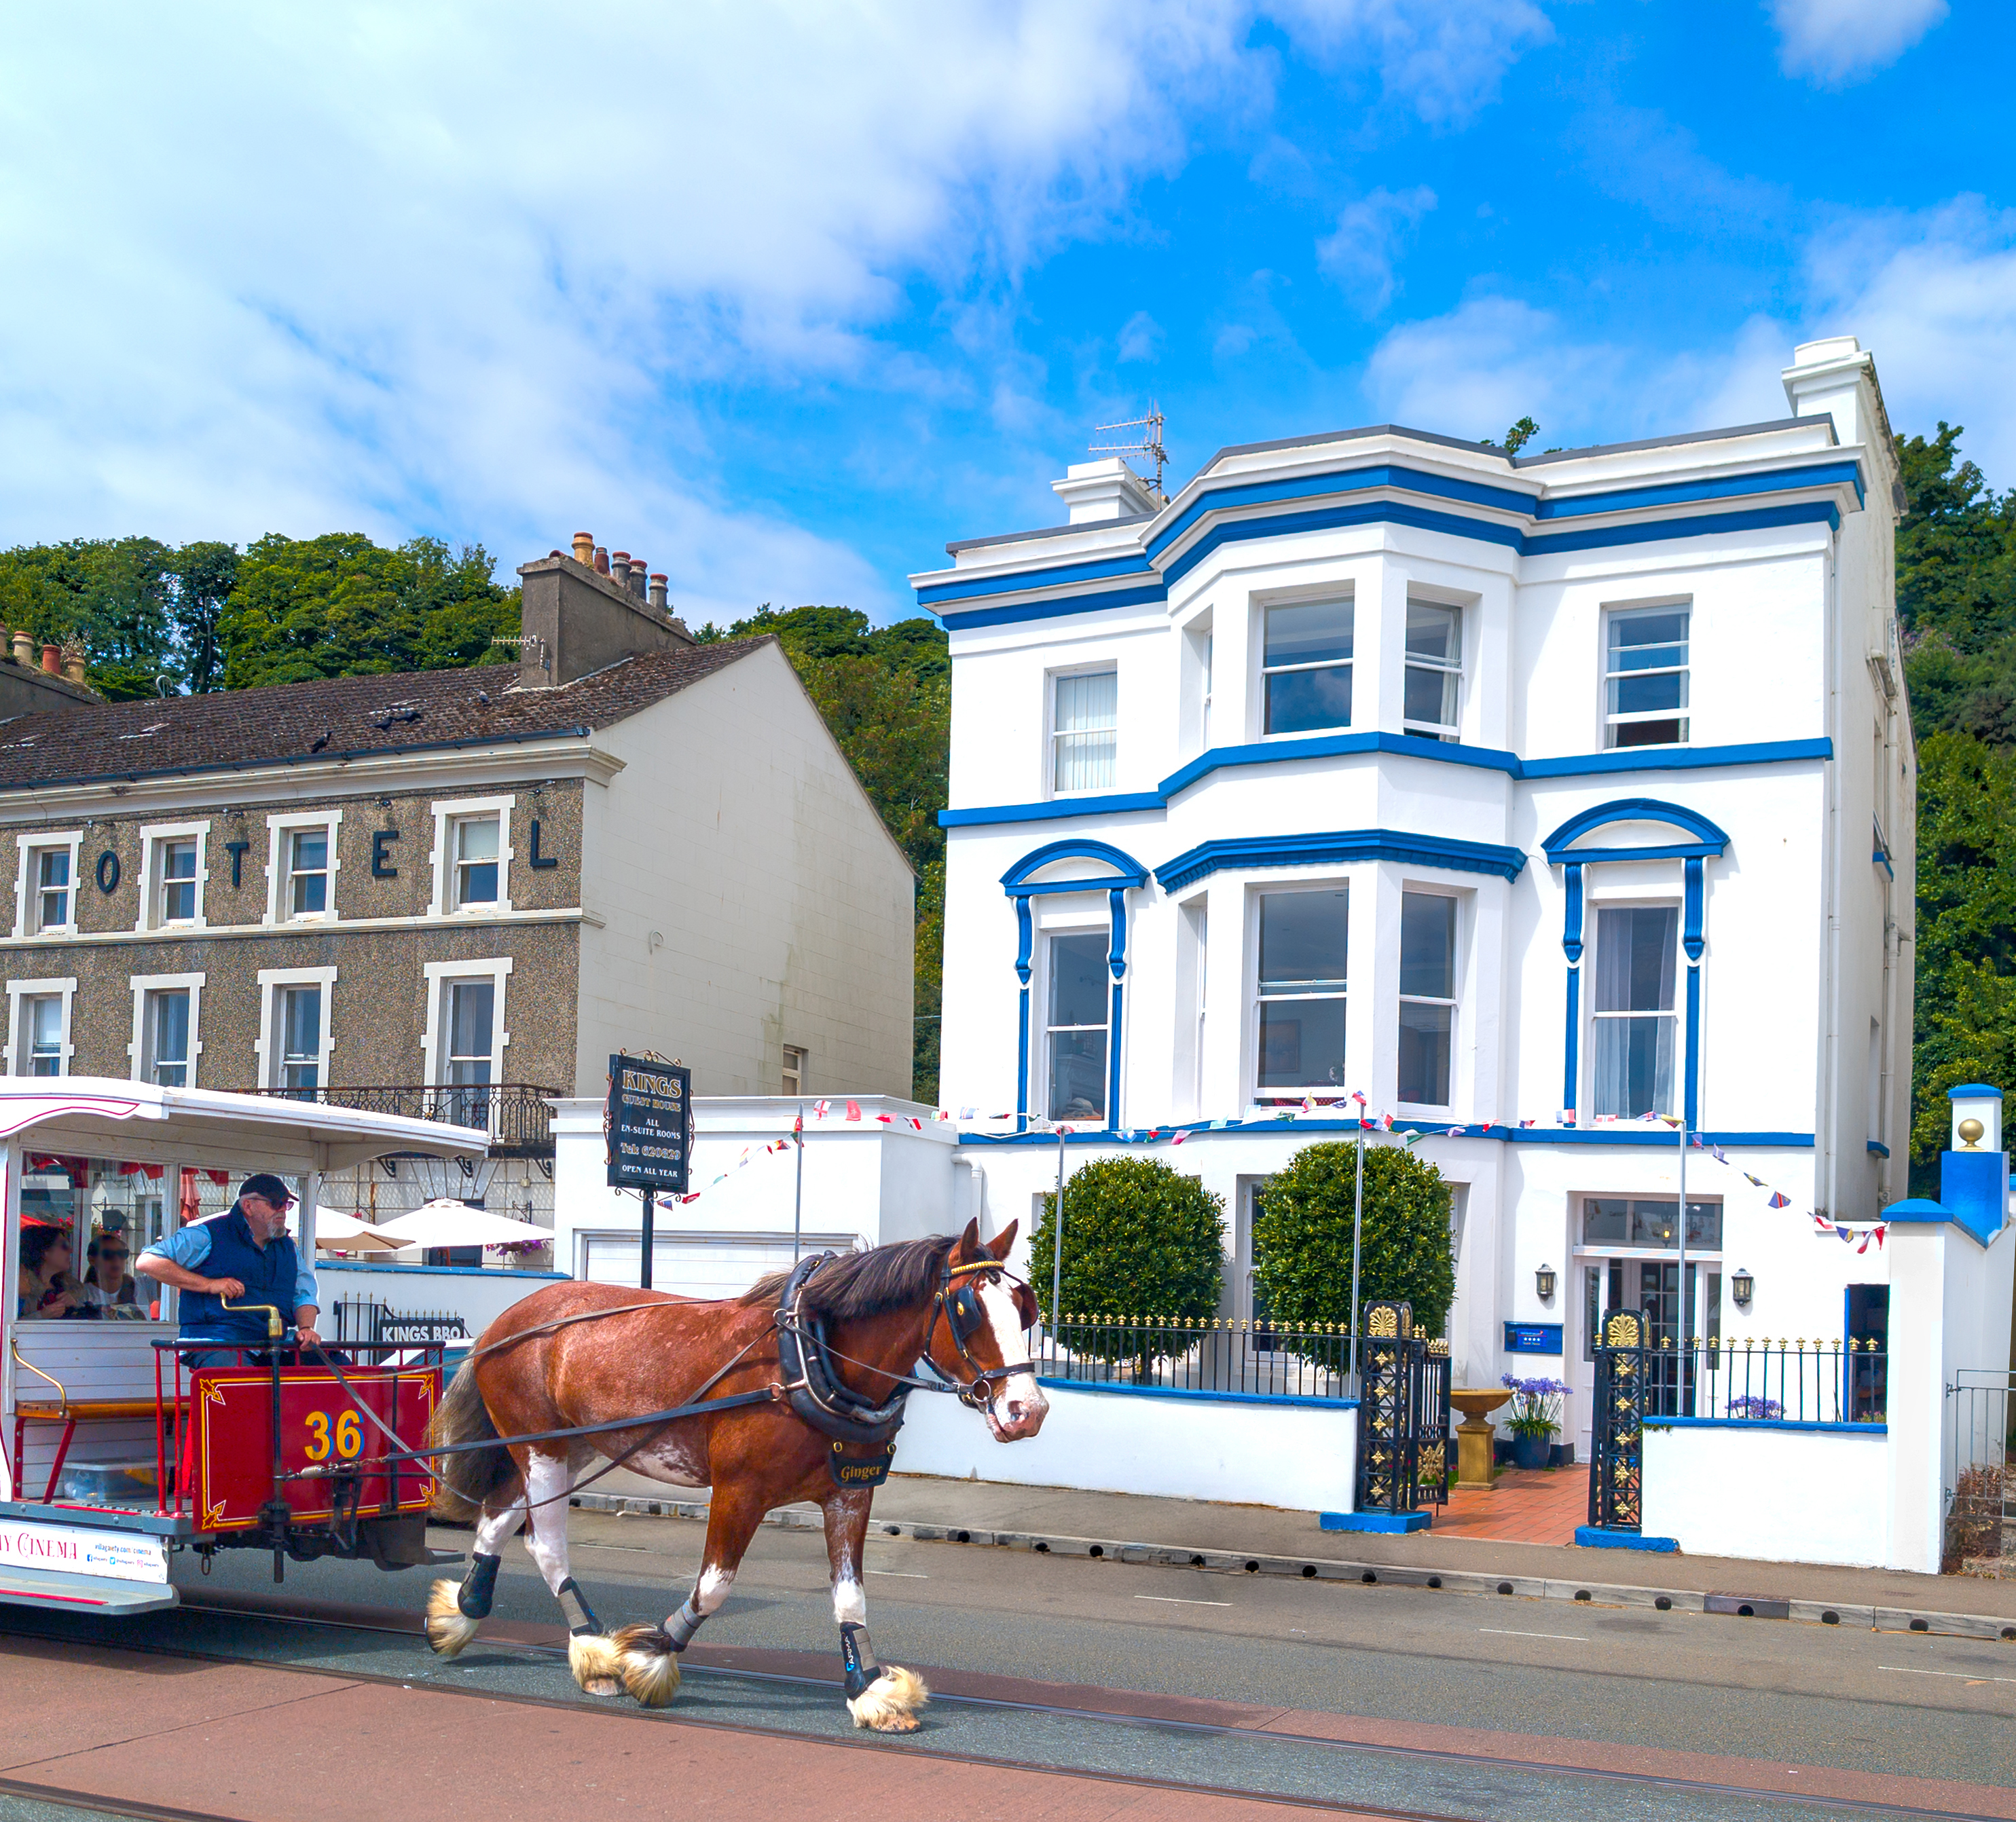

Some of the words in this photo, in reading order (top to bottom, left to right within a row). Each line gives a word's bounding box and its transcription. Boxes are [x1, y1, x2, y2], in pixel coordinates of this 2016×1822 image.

[623, 1070, 682, 1098] KINGS
[622, 1094, 650, 1107] GUEST
[653, 1099, 682, 1112] HOUSE
[646, 1118, 660, 1127] ALL
[621, 1124, 655, 1136] EN-SUITE
[657, 1129, 681, 1140] ROOMS
[621, 1142, 640, 1155] Tel:
[622, 1164, 642, 1173] OPEN
[644, 1167, 657, 1175] ALL
[659, 1168, 678, 1178] YEAR
[382, 1326, 429, 1341] KINGS
[304, 1409, 365, 1461] 36
[841, 1466, 883, 1484] Ginger
[18, 1532, 77, 1560] CINEMA
